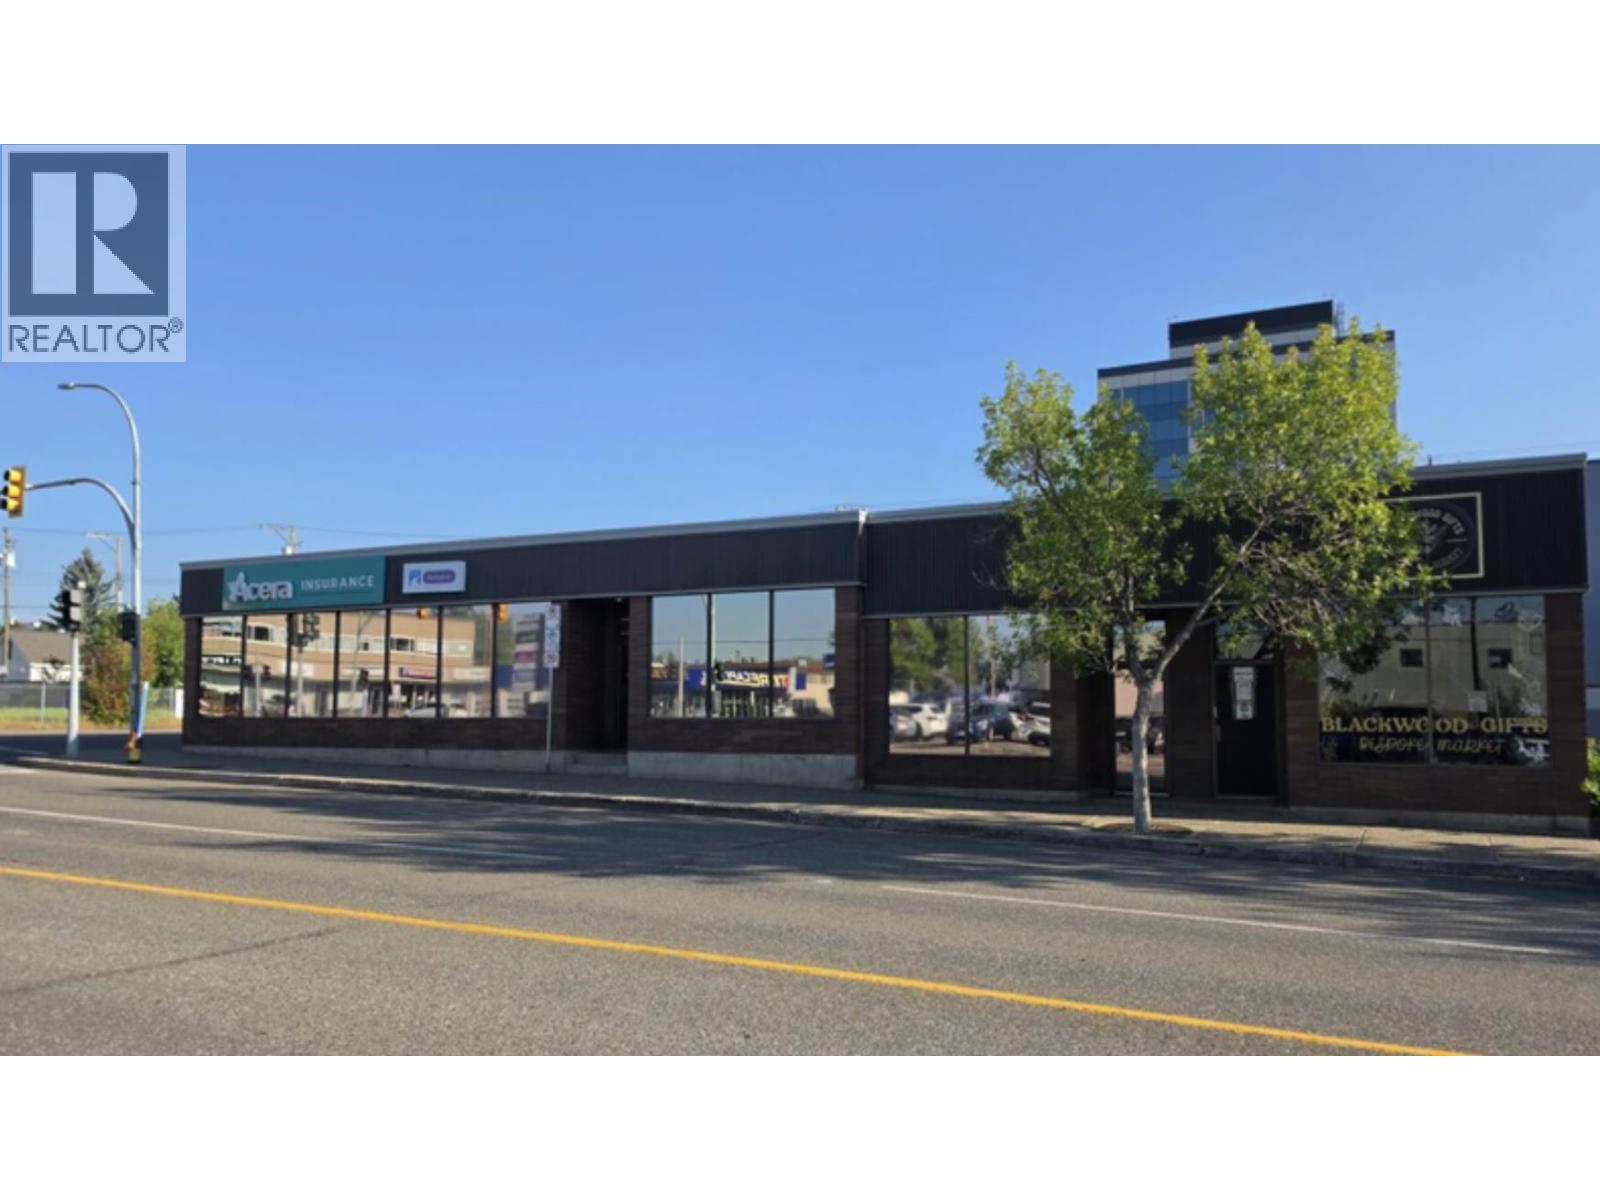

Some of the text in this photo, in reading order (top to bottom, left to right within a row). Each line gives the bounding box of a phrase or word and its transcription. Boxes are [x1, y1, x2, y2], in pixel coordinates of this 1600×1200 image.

[228, 571, 374, 600] Acera INSURANCE
[1320, 716, 1549, 734] BLACKWOOD GIFTS
